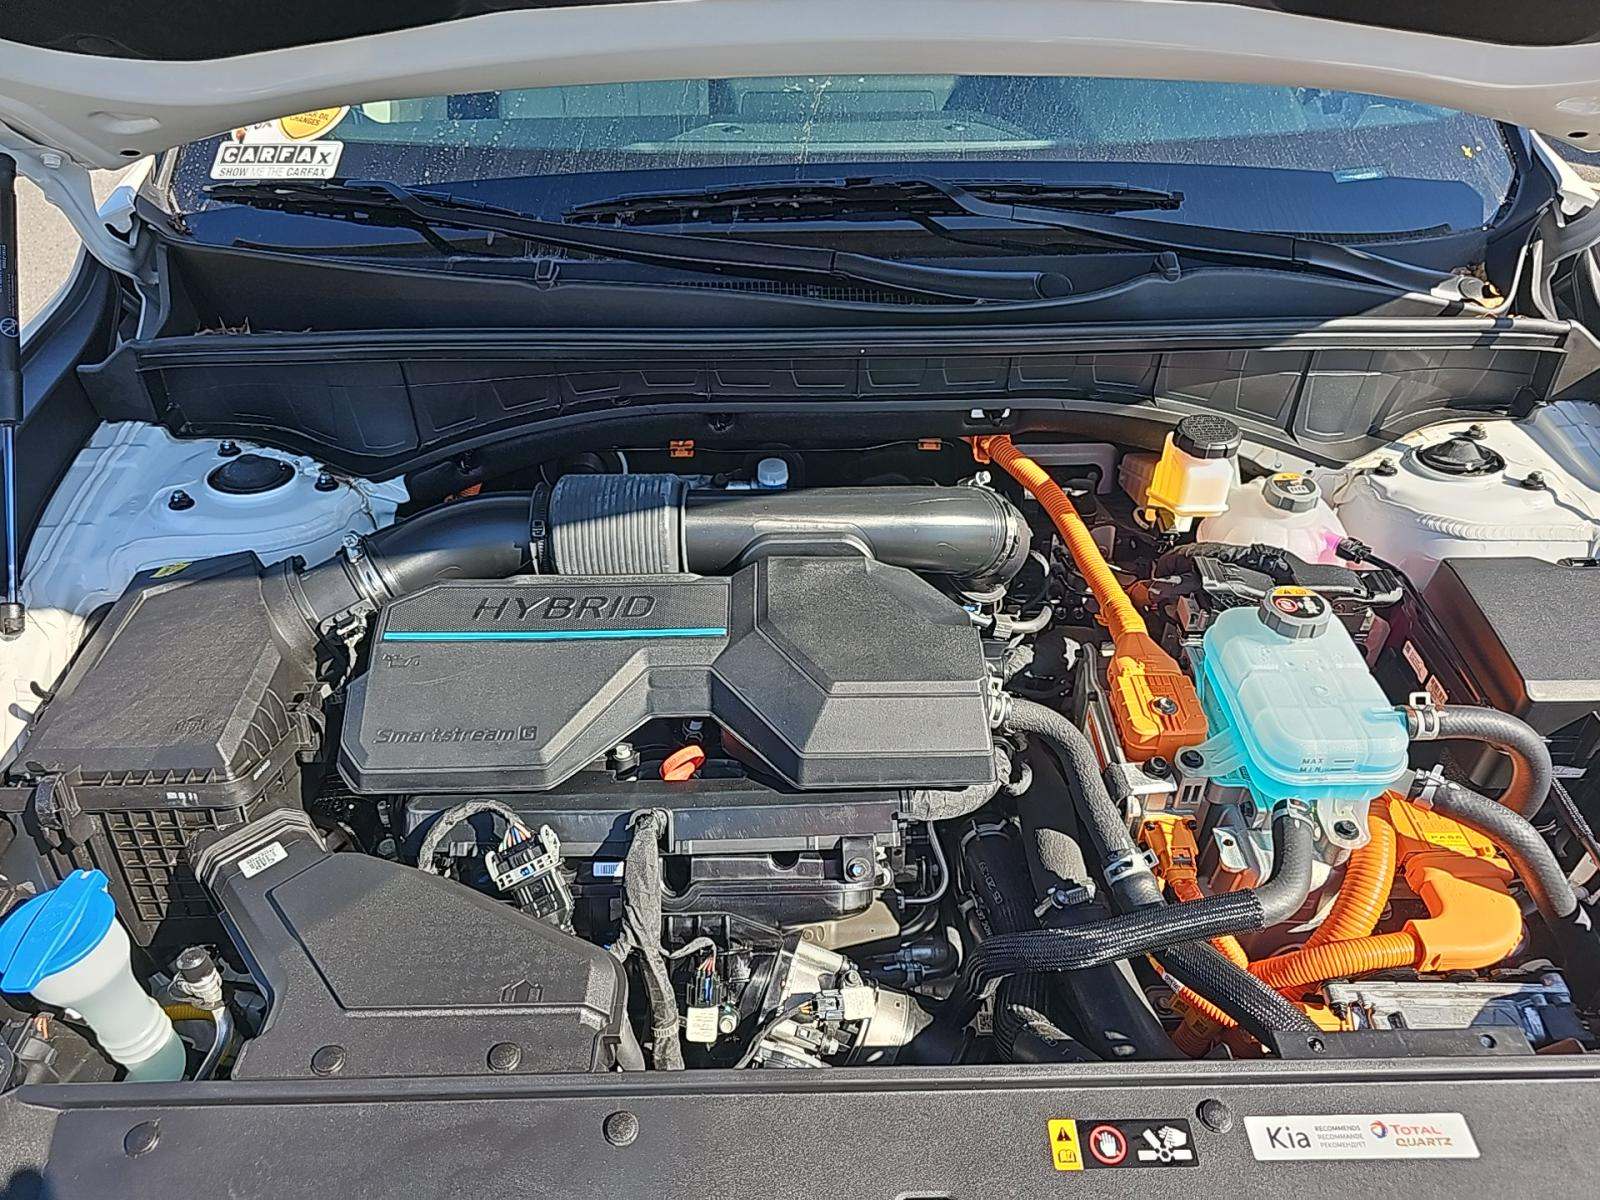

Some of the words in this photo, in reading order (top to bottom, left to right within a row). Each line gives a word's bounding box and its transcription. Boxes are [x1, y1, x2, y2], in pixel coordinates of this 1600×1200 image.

[220, 146, 331, 164] CARFAX
[219, 167, 247, 177] SHOW
[267, 167, 285, 177] THE
[286, 167, 327, 177] CARFAX
[472, 595, 657, 621] HYBRID
[372, 727, 515, 744] Smartstream
[1314, 1124, 1361, 1132] RECOMMENDS
[1388, 1124, 1442, 1136] TOTAL
[1265, 1126, 1312, 1149] Kia
[1395, 1137, 1454, 1147] QUARTZ
